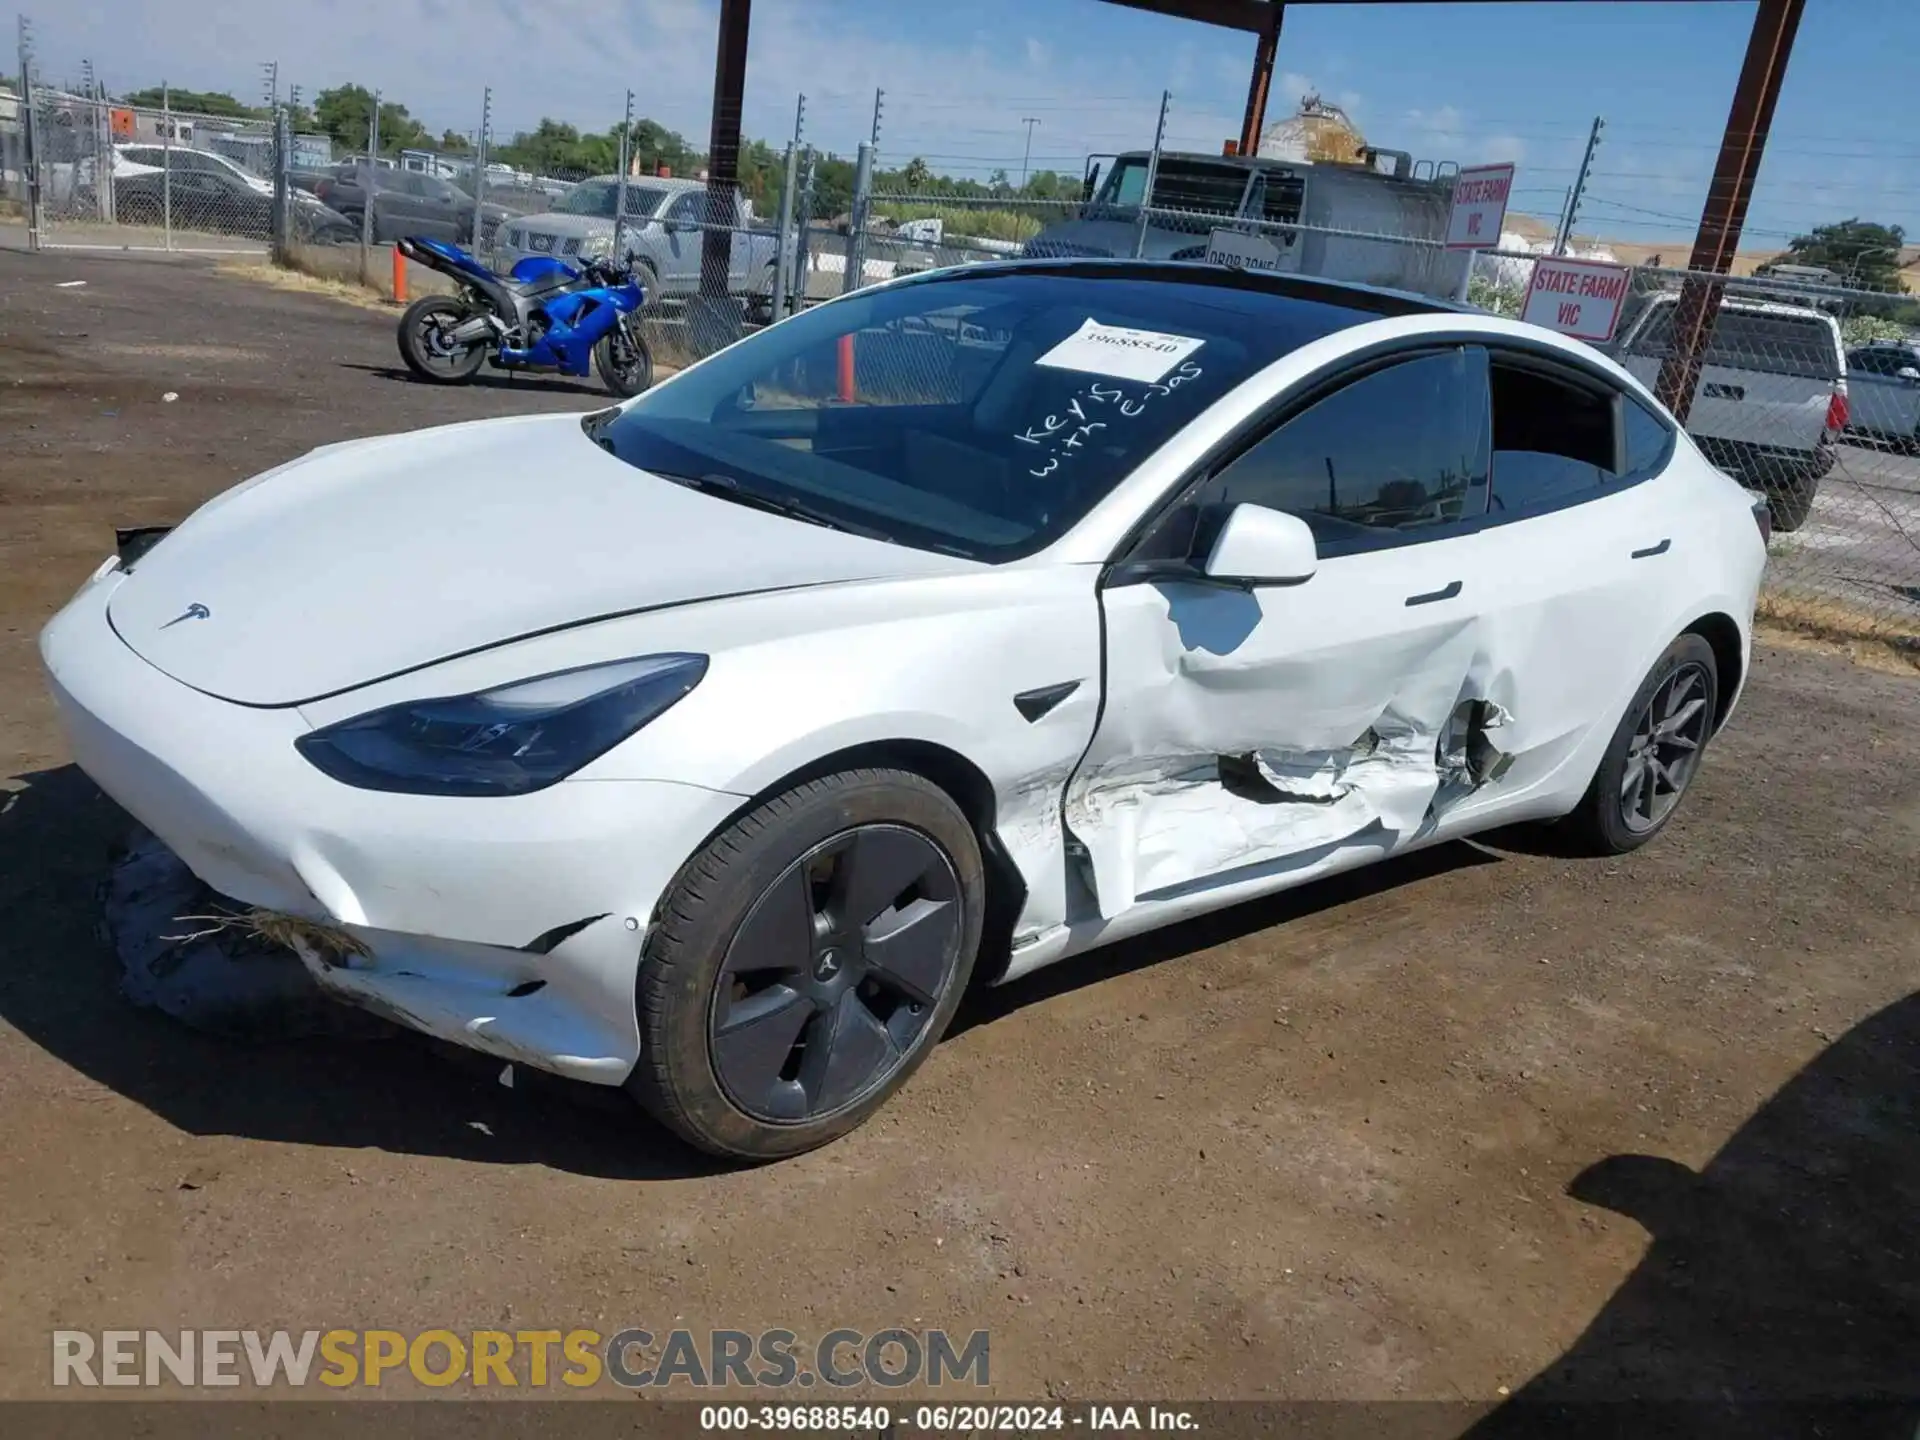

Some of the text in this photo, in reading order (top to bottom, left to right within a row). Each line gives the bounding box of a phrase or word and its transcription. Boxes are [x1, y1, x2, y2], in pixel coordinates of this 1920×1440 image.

[1456, 177, 1509, 204] STATE FARM
[1467, 213, 1483, 235] VIC
[1210, 250, 1241, 267] DROP
[1536, 268, 1621, 300] STATE FARM
[1558, 302, 1581, 326] VIC
